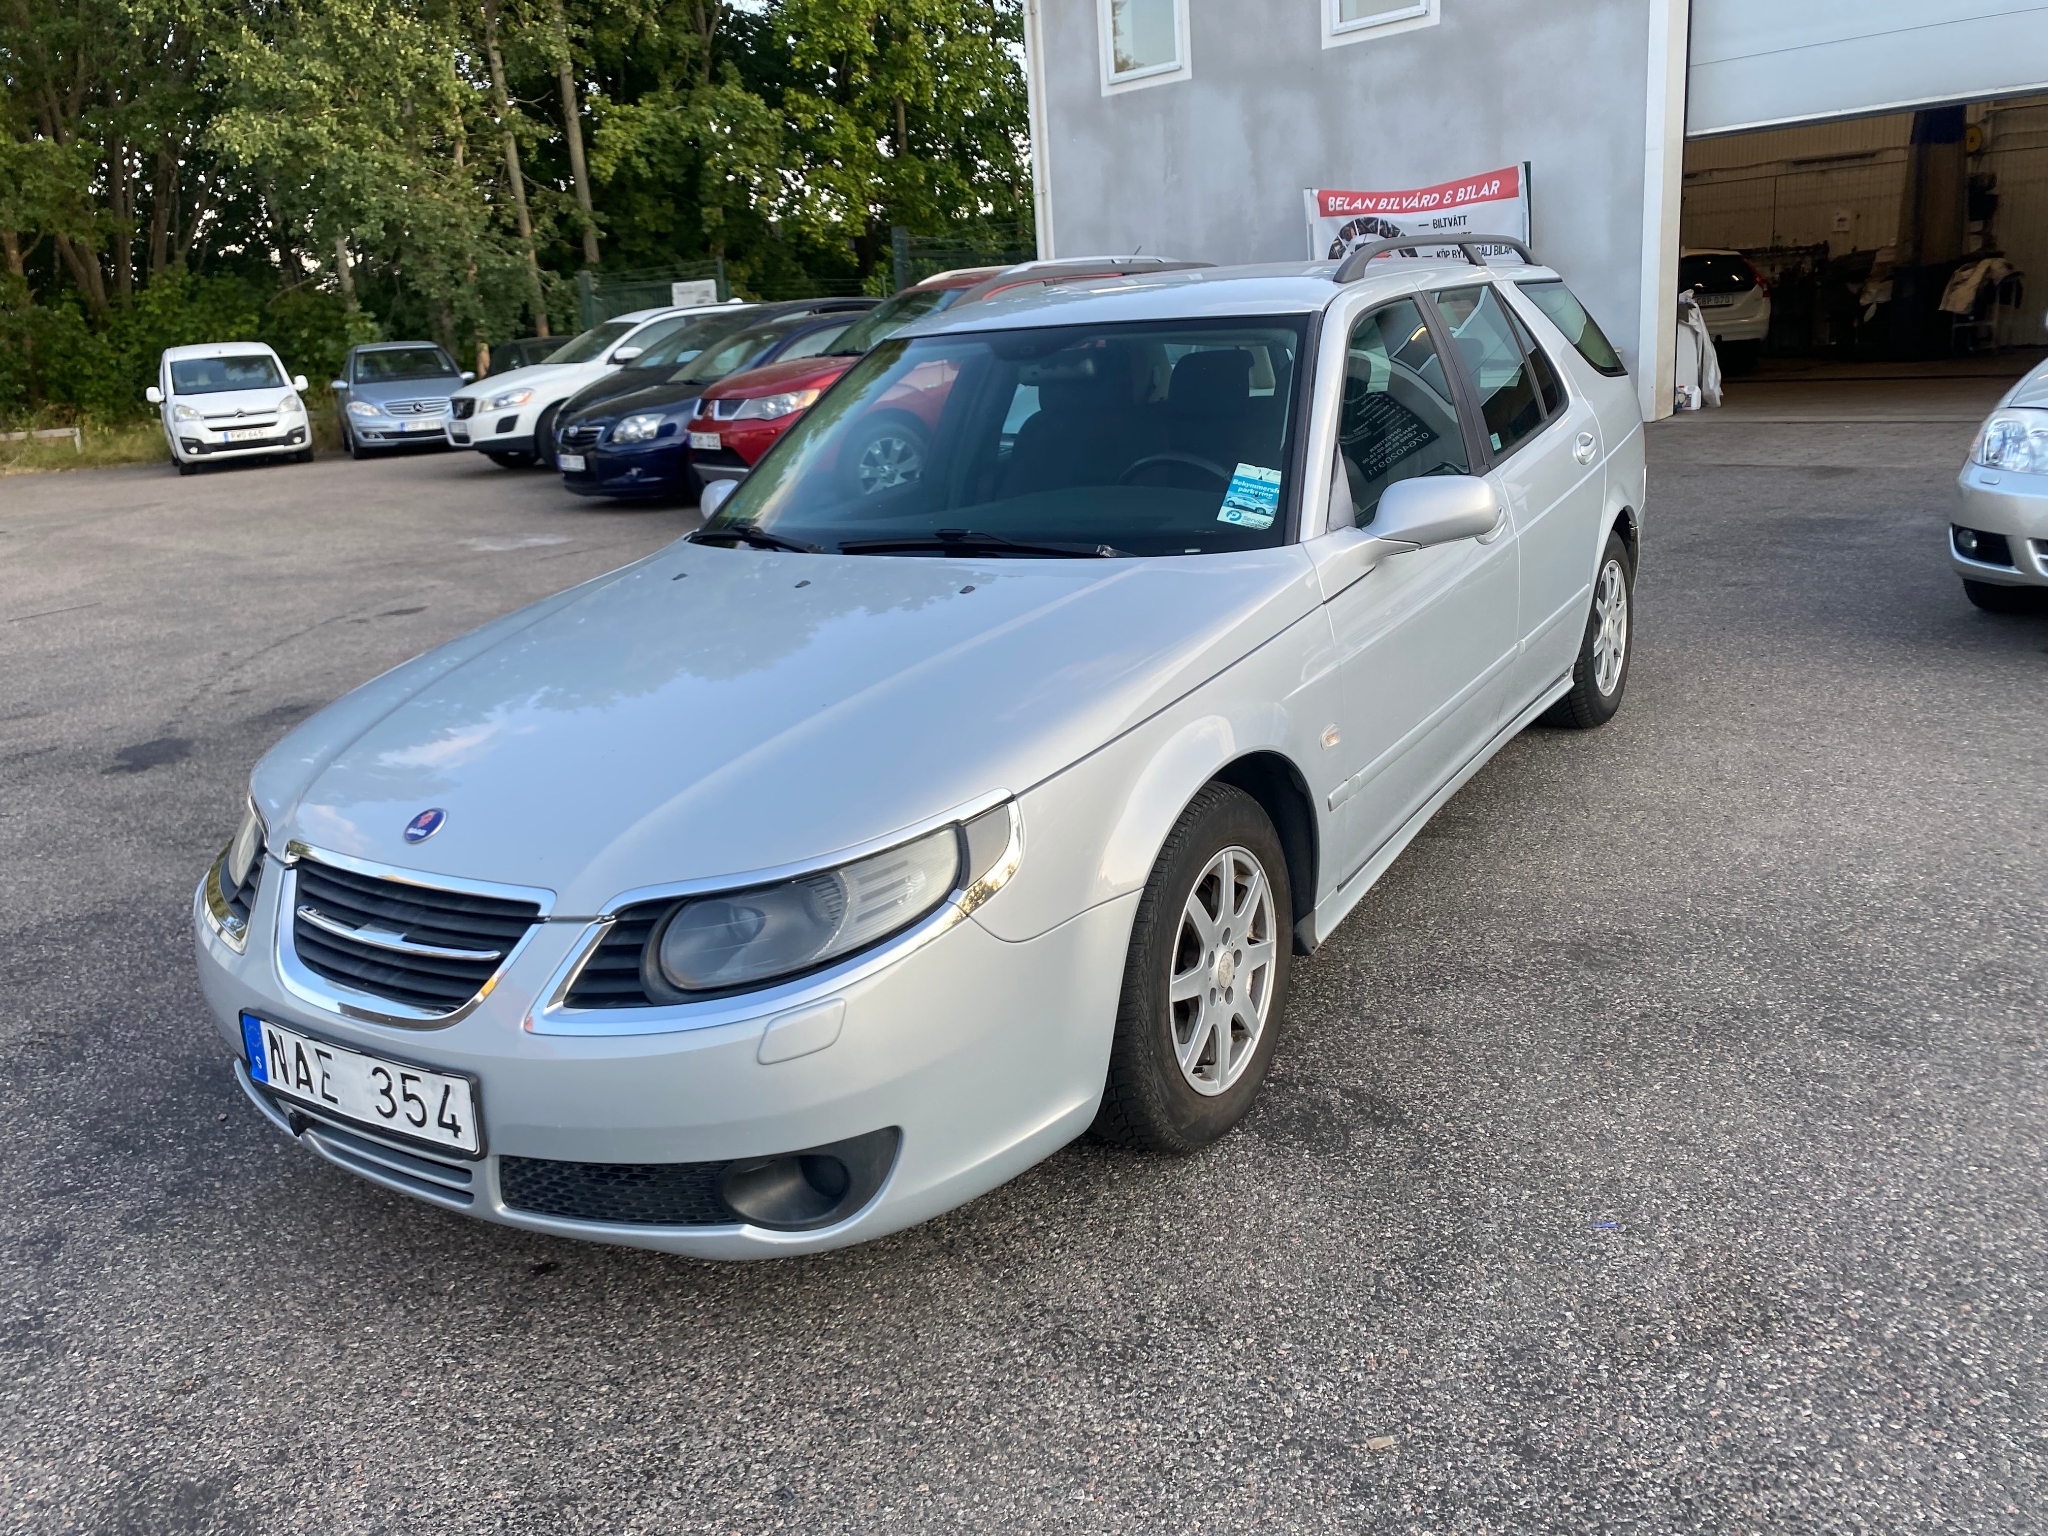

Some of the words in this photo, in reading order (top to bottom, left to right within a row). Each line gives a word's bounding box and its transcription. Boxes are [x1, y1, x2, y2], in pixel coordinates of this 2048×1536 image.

[1328, 196, 1376, 212] BELAN
[1377, 191, 1440, 210] BILVÅRD
[1443, 190, 1453, 203] &
[1455, 179, 1501, 202] BILAR
[254, 1055, 263, 1070] S
[267, 1028, 340, 1105] NAE
[371, 1065, 462, 1139] 354
